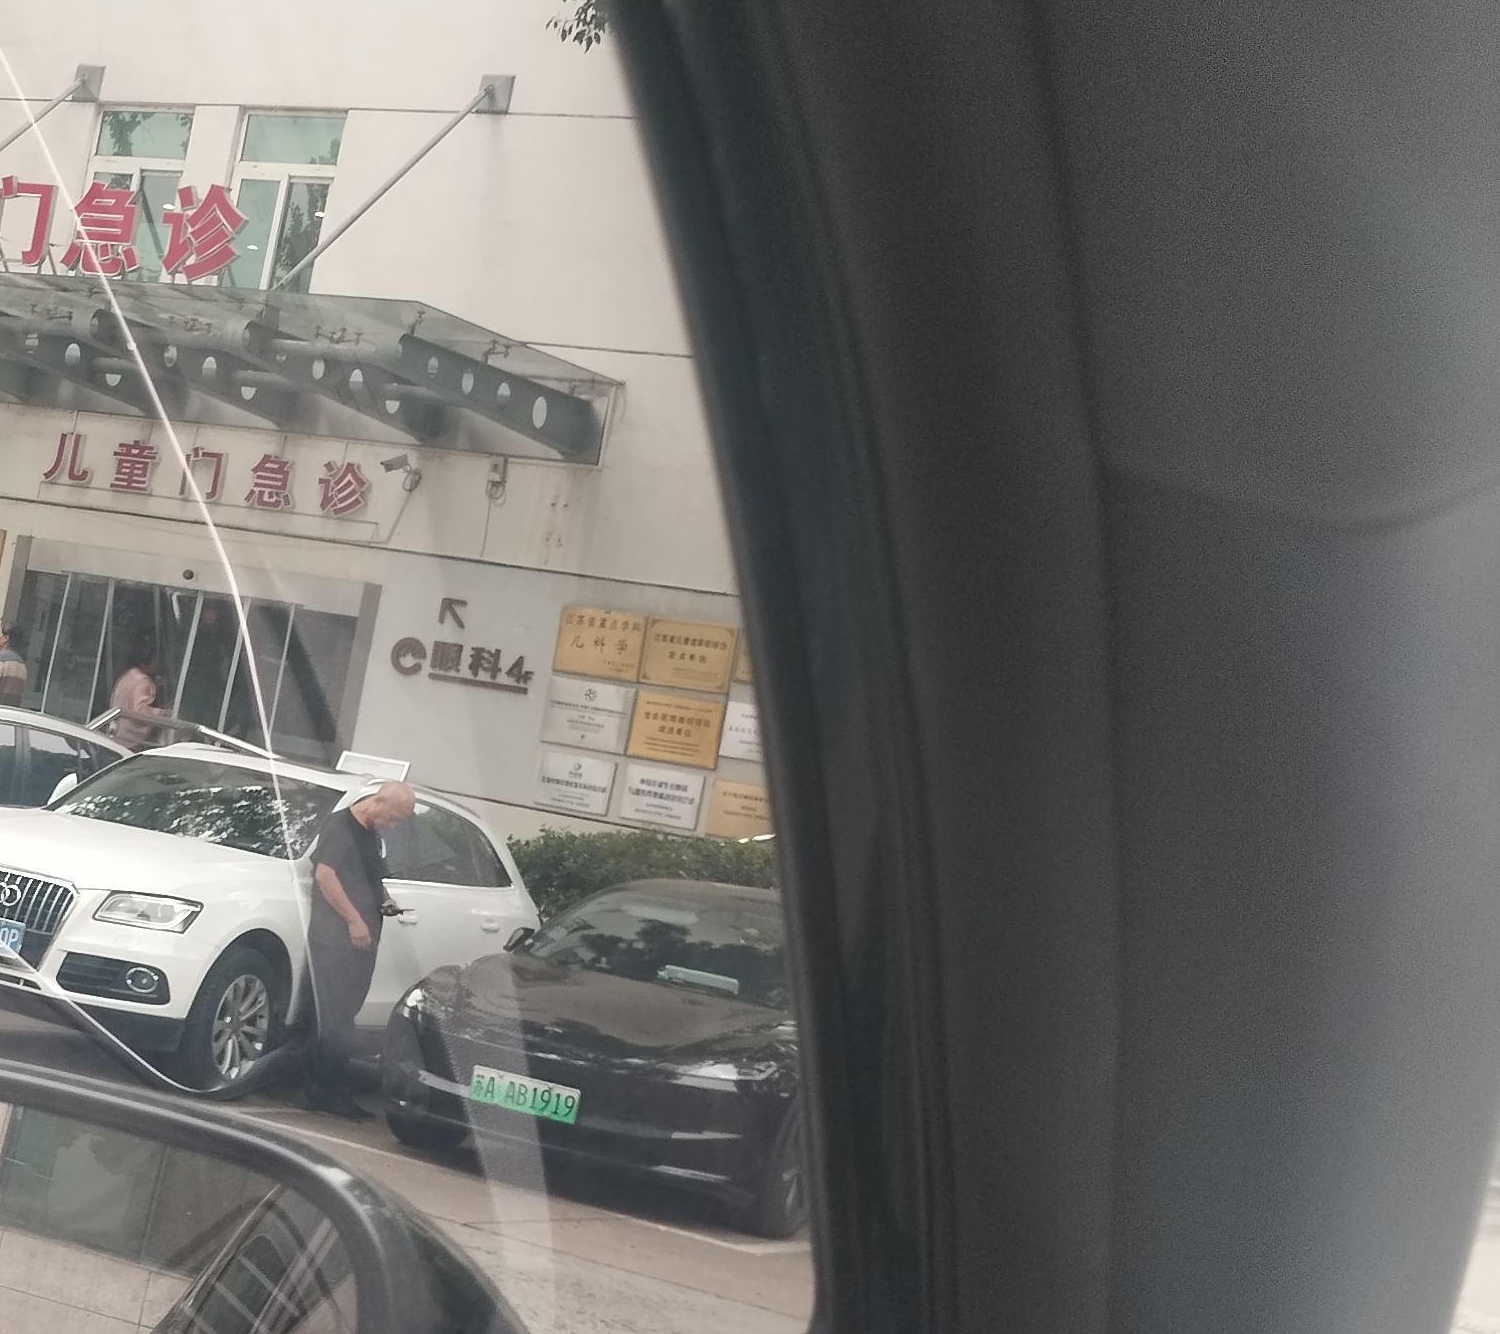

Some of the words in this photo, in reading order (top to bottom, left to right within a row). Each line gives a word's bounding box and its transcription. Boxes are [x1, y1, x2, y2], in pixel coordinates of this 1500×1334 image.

[44, 432, 372, 517] 儿童门急诊
